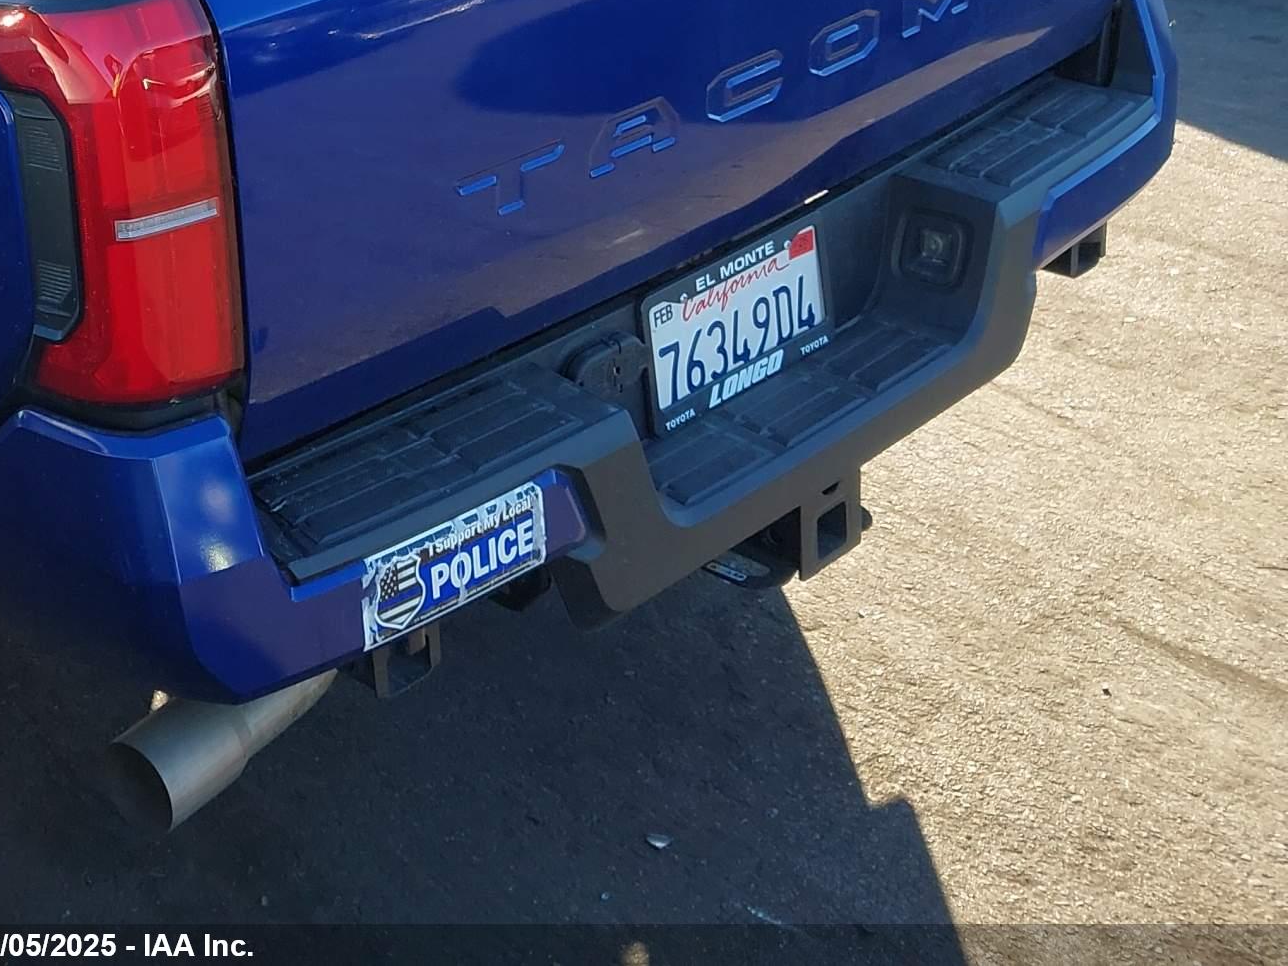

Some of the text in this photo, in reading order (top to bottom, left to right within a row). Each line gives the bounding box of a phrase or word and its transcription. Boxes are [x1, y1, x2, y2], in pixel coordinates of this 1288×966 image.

[696, 274, 716, 292] EL
[720, 240, 775, 279] MONTE
[682, 257, 790, 321] California
[653, 304, 674, 328] FEB
[800, 335, 830, 355] TOYOTA
[708, 349, 784, 409] LONGO
[665, 408, 696, 431] TOYOTA
[502, 495, 532, 522] Local
[430, 518, 534, 600] POLICE
